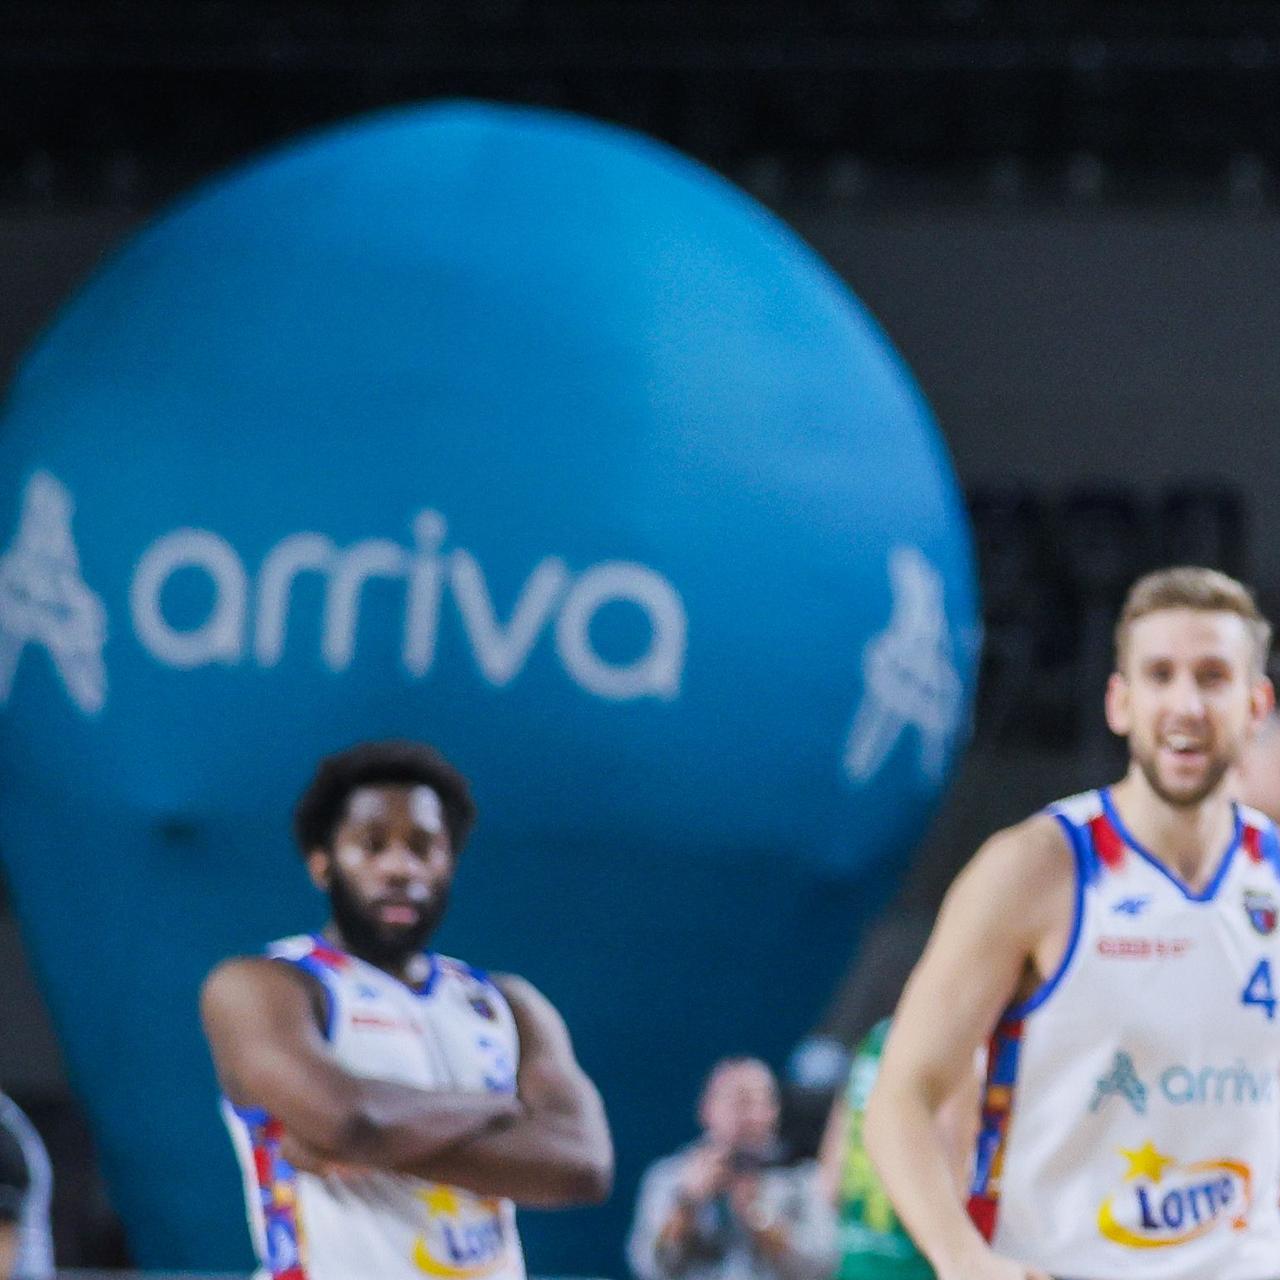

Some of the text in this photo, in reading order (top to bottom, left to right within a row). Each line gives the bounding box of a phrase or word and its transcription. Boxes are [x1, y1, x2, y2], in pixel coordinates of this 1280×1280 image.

[130, 509, 688, 701] arriva
[1242, 957, 1277, 1021] 4
[1136, 1173, 1234, 1230] LOTTO
